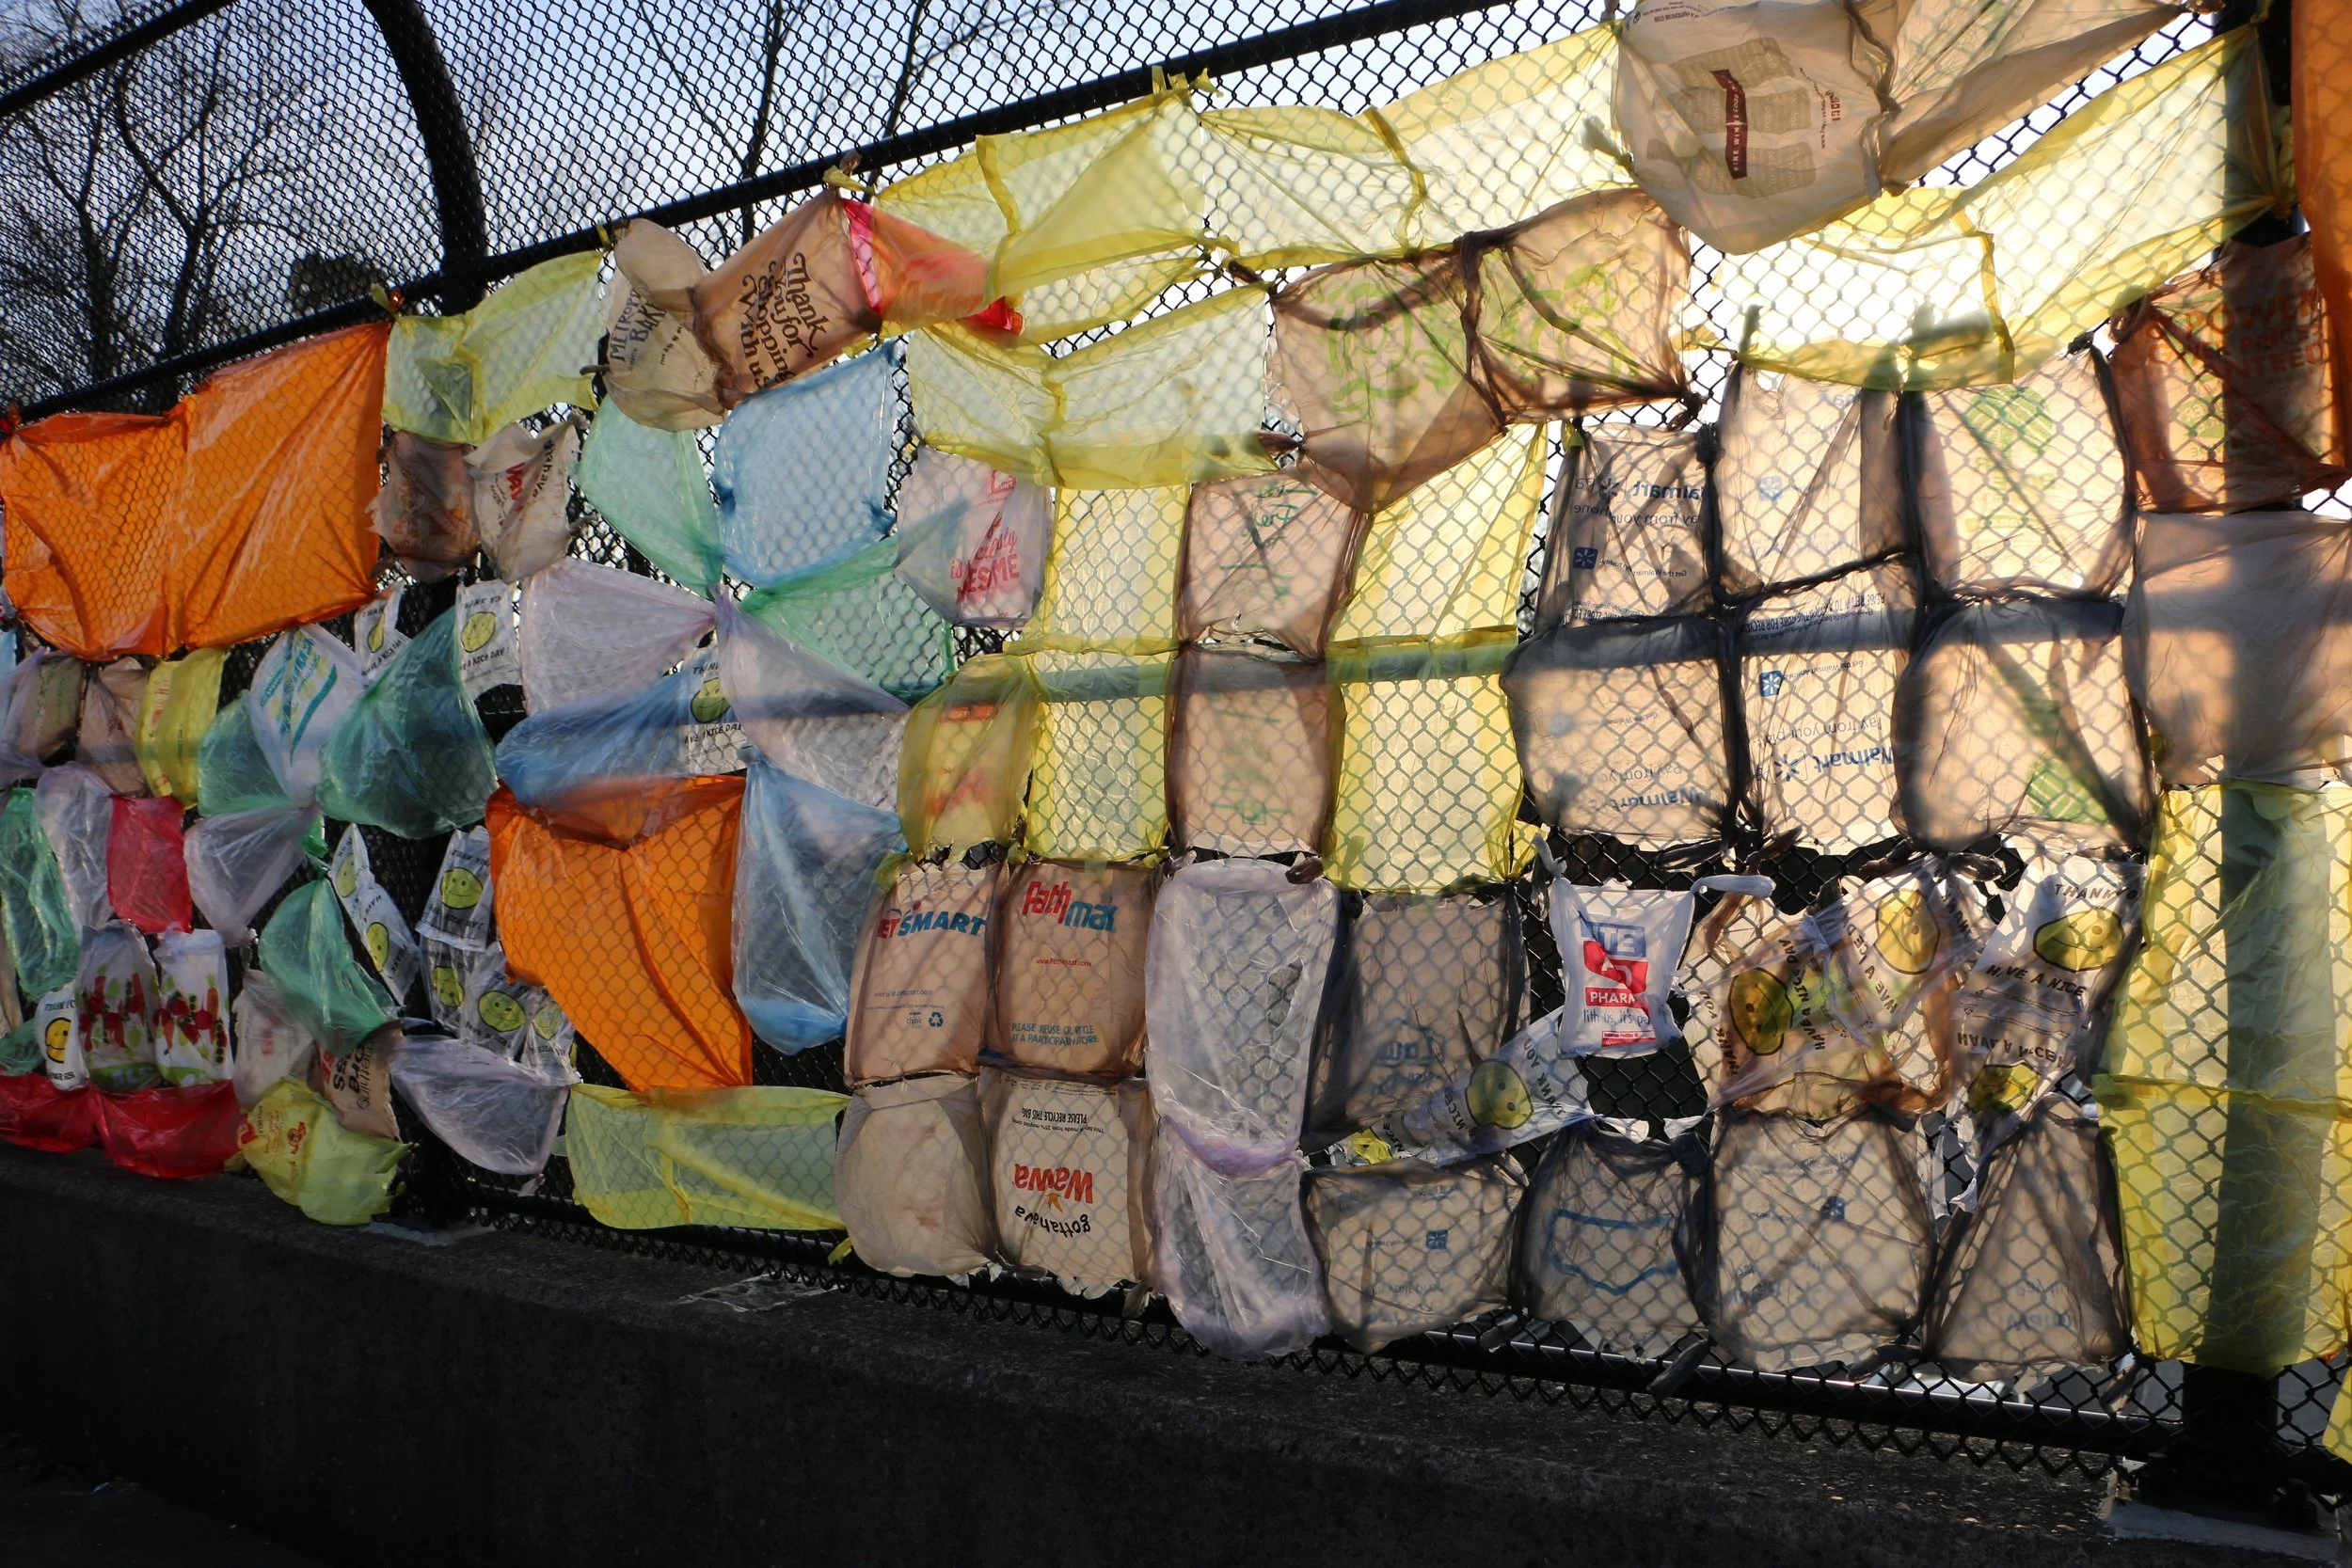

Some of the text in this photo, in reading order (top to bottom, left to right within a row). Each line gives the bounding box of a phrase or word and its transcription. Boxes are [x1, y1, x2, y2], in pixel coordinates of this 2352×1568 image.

[787, 252, 829, 351] Thank
[771, 312, 815, 358] for
[1823, 721, 1857, 736] from
[2030, 973, 2042, 985] A
[2047, 977, 2087, 997] NICE
[1590, 990, 1637, 1004] PHAR
[1800, 1006, 1812, 1018] A
[1805, 1017, 1826, 1051] HAVE
[1044, 1110, 1067, 1123] RECYCLE
[1067, 1113, 1088, 1124] PLEASE
[1014, 1164, 1093, 1204] Wawa
